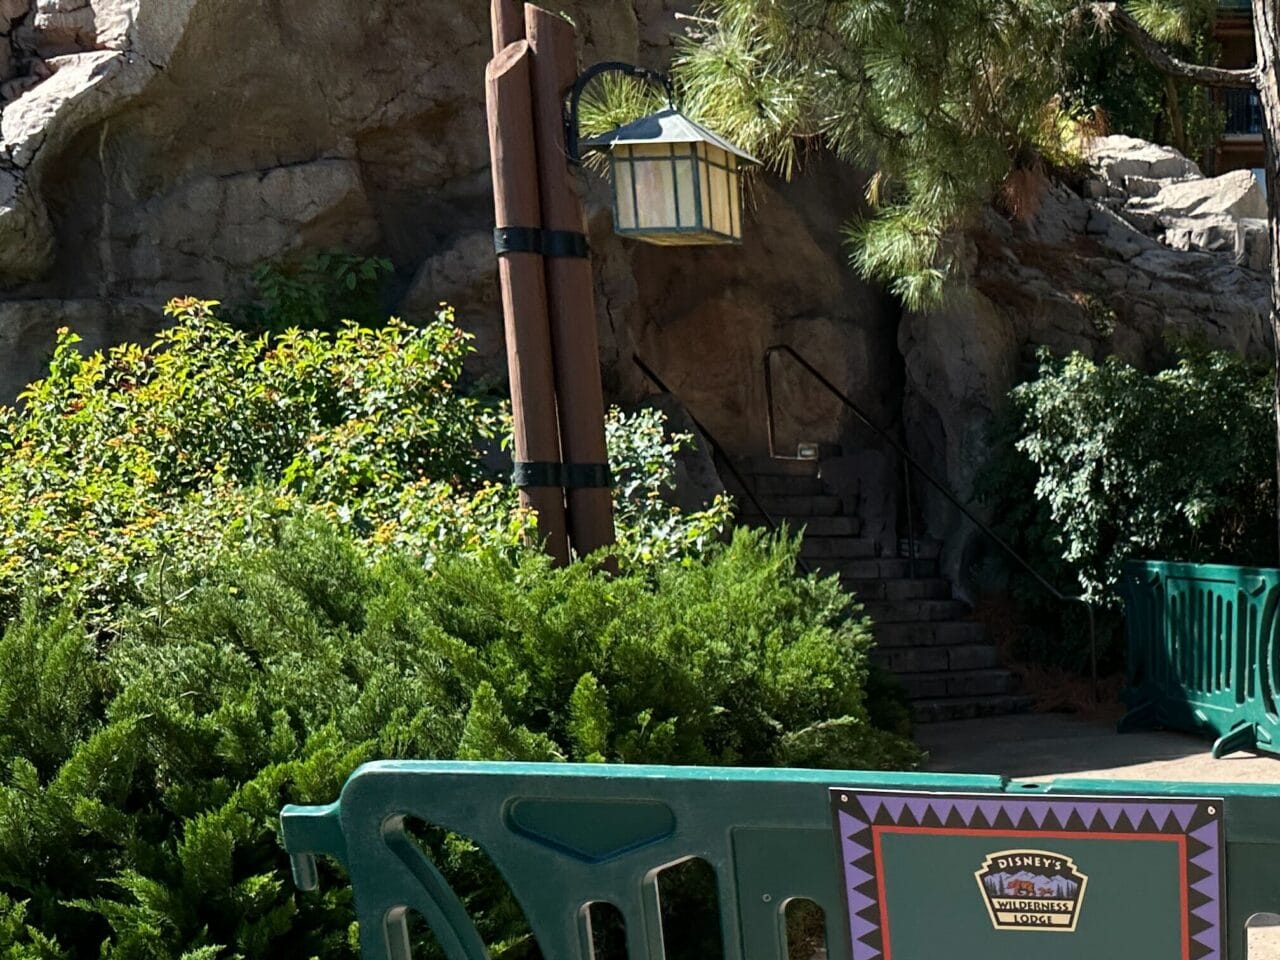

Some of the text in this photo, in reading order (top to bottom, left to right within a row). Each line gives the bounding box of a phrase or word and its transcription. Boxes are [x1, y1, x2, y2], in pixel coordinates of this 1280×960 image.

[998, 857, 1061, 870] DISNEY'S
[997, 901, 1069, 911] WILDERNESS
[1014, 914, 1052, 924] LODGE
